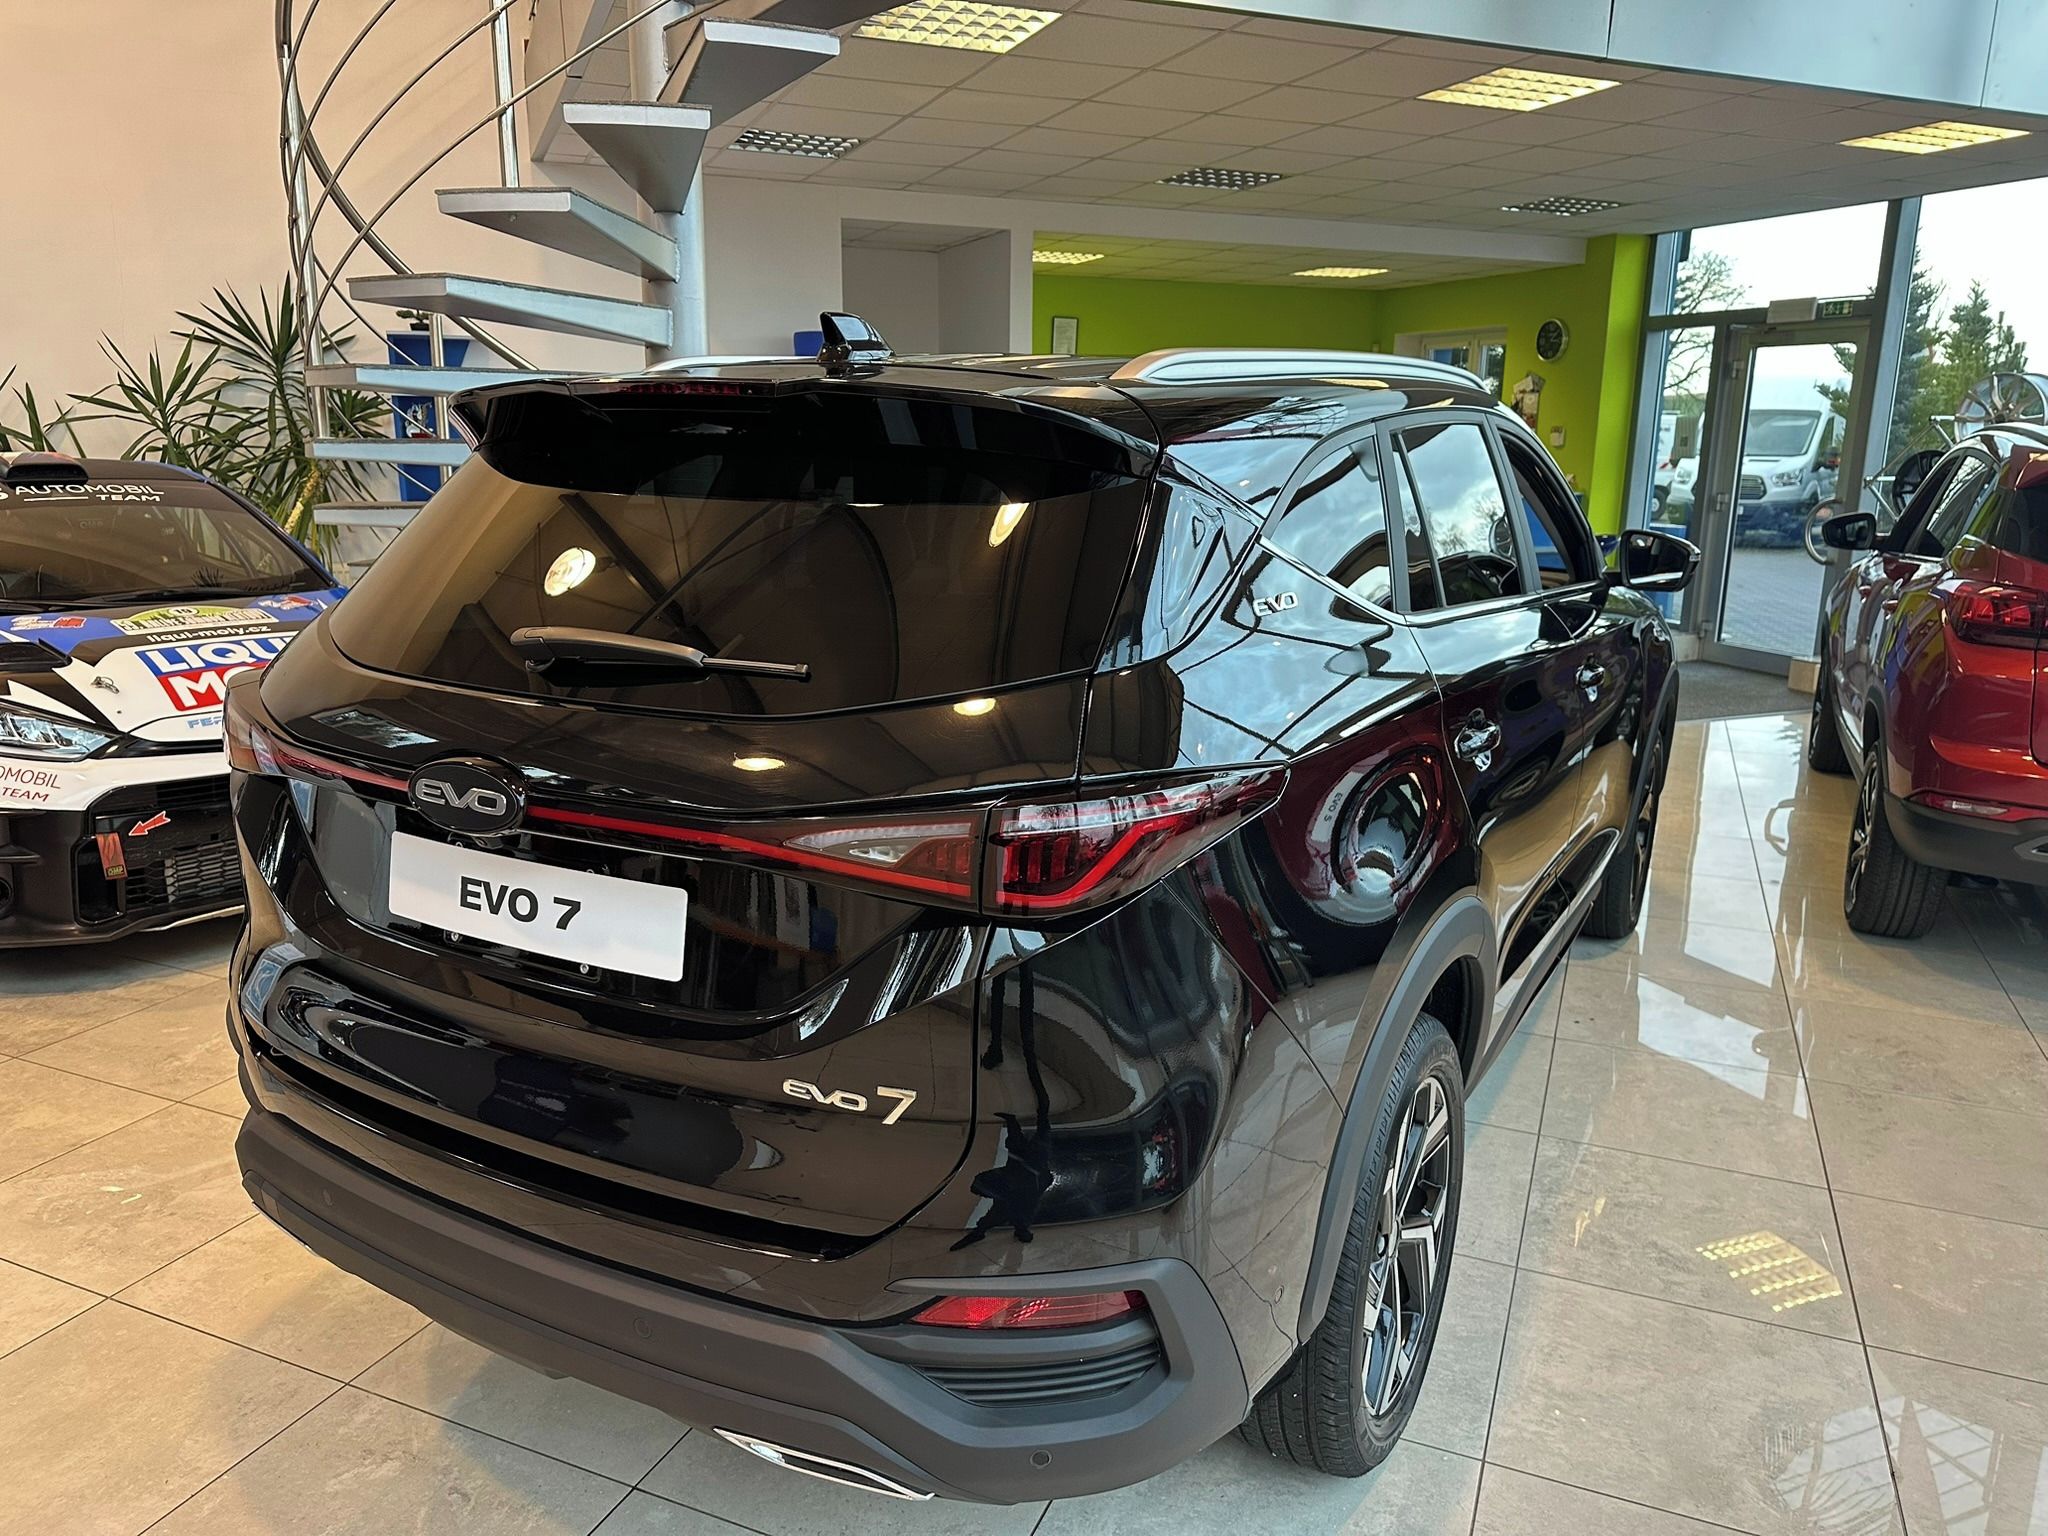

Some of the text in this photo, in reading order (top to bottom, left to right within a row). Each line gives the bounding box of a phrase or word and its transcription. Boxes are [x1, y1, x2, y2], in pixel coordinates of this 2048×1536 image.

[16, 484, 164, 496] AUTOMOBIL
[1253, 591, 1298, 617] EVO
[146, 625, 271, 643] liqui-moly.cz
[2, 786, 50, 802] TEAM
[415, 778, 507, 816] EVO
[460, 875, 581, 931] EVO 7
[782, 1079, 917, 1125] EVO 7
